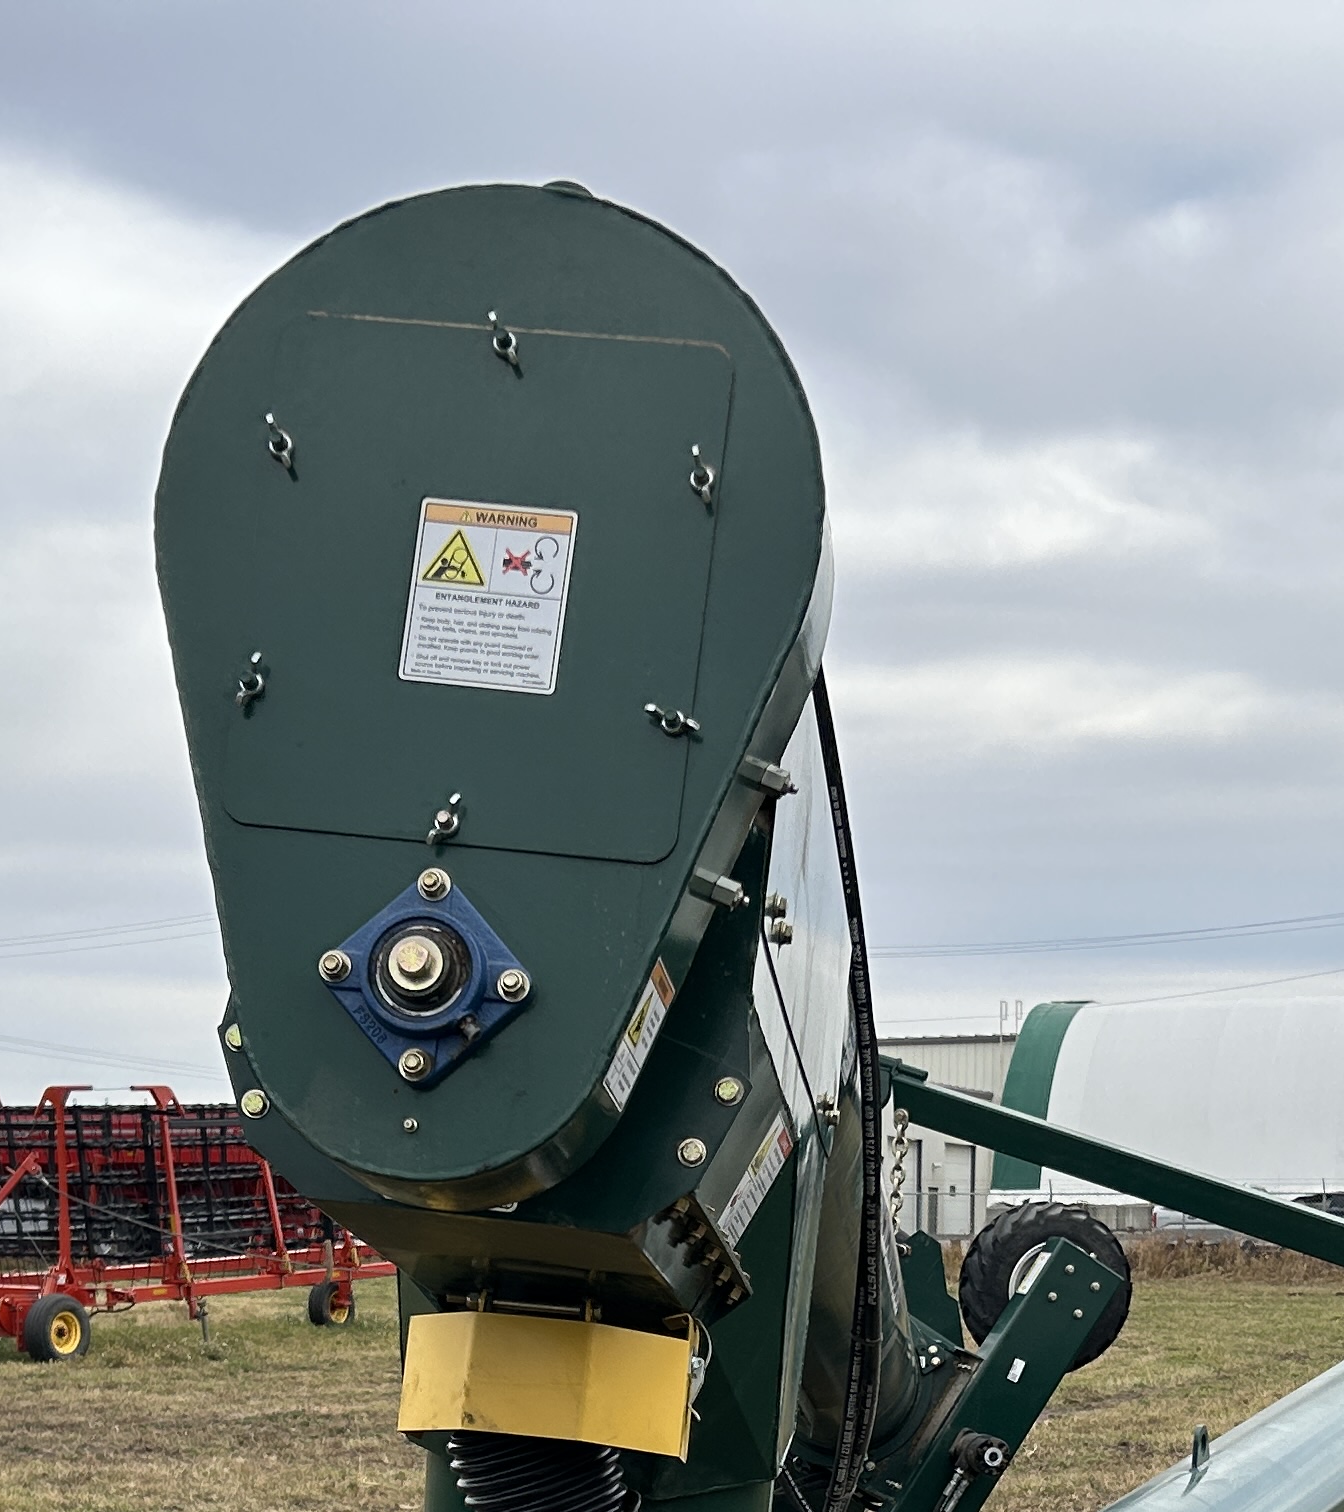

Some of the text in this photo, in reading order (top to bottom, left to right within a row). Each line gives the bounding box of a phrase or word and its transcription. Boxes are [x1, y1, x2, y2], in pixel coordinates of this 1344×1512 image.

[475, 511, 537, 528] WARNING
[435, 592, 540, 609] ENTANGLEMENT HAZARD
[864, 1256, 878, 1305] PULSAR
